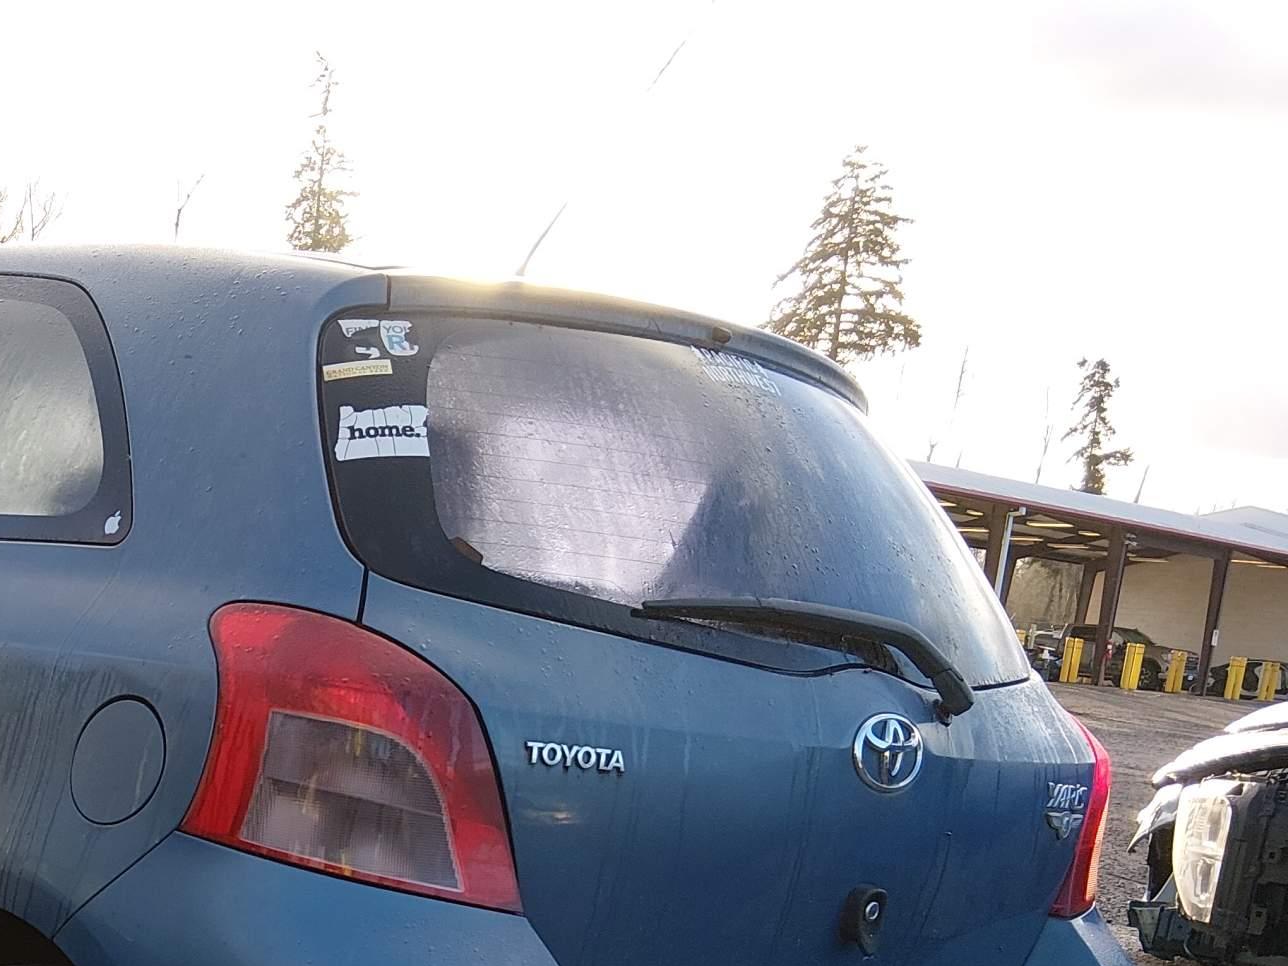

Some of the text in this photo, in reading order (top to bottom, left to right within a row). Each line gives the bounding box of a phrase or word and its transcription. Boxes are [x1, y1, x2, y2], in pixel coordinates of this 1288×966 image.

[382, 325, 408, 335] YO
[702, 364, 781, 396] NORTHWEST
[347, 425, 421, 440] home.
[525, 741, 625, 772] TOYOTA
